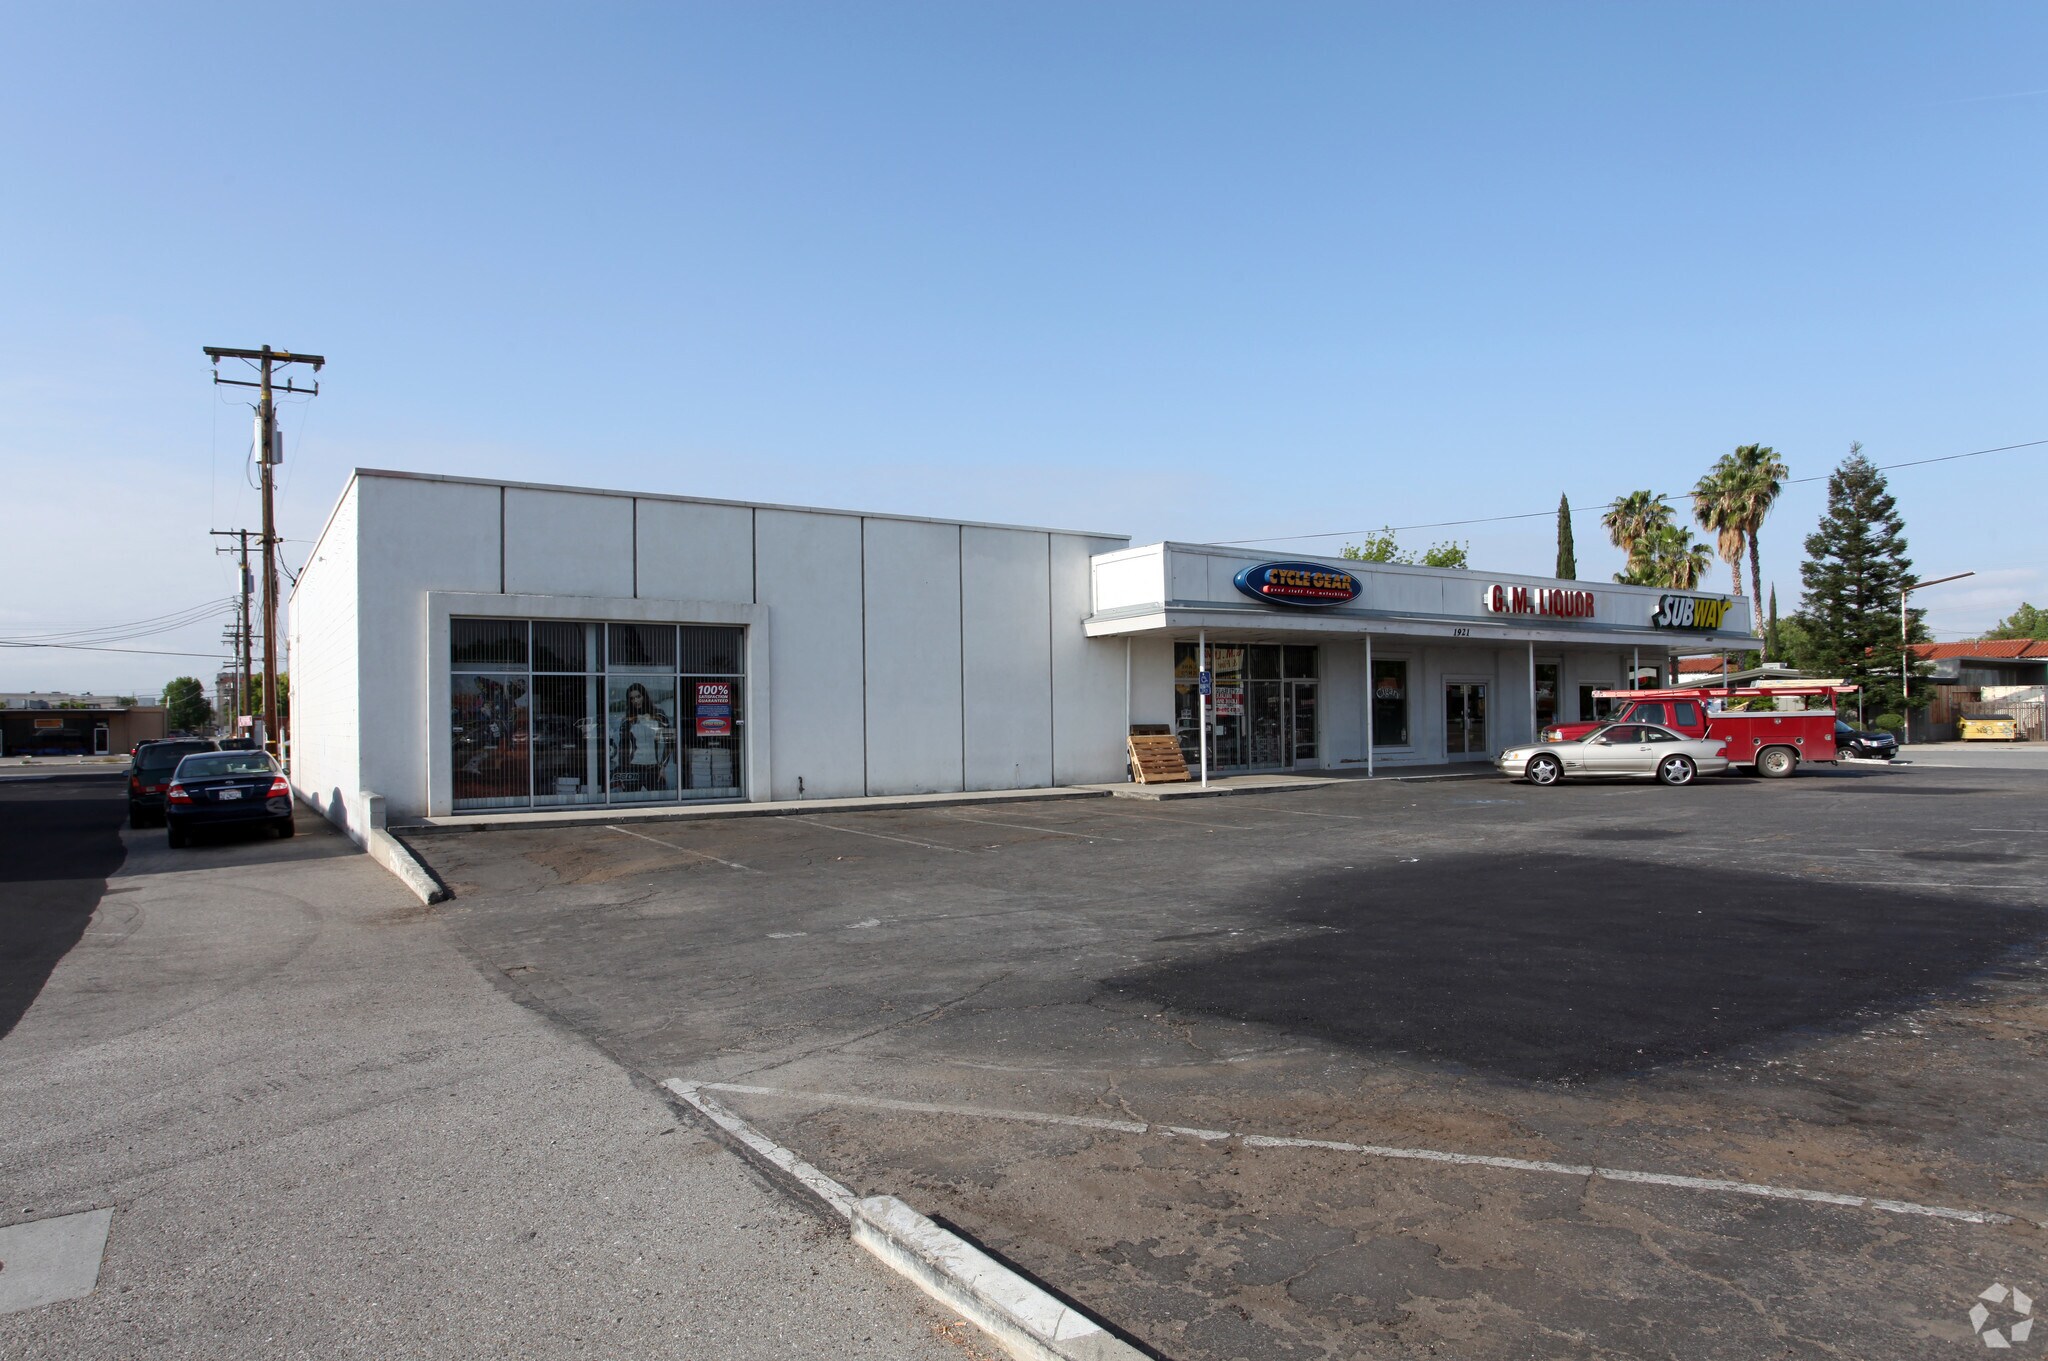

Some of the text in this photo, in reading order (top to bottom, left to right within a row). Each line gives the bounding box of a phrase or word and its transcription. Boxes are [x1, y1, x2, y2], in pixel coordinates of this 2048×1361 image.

[1269, 568, 1352, 589] CYCLE GEAR
[1318, 590, 1350, 598] motorbikes
[1491, 584, 1595, 619] G.M. LIQUOR
[1657, 596, 1733, 629] SUBWAY
[1453, 628, 1470, 637] 1921
[698, 685, 729, 695] 100%
